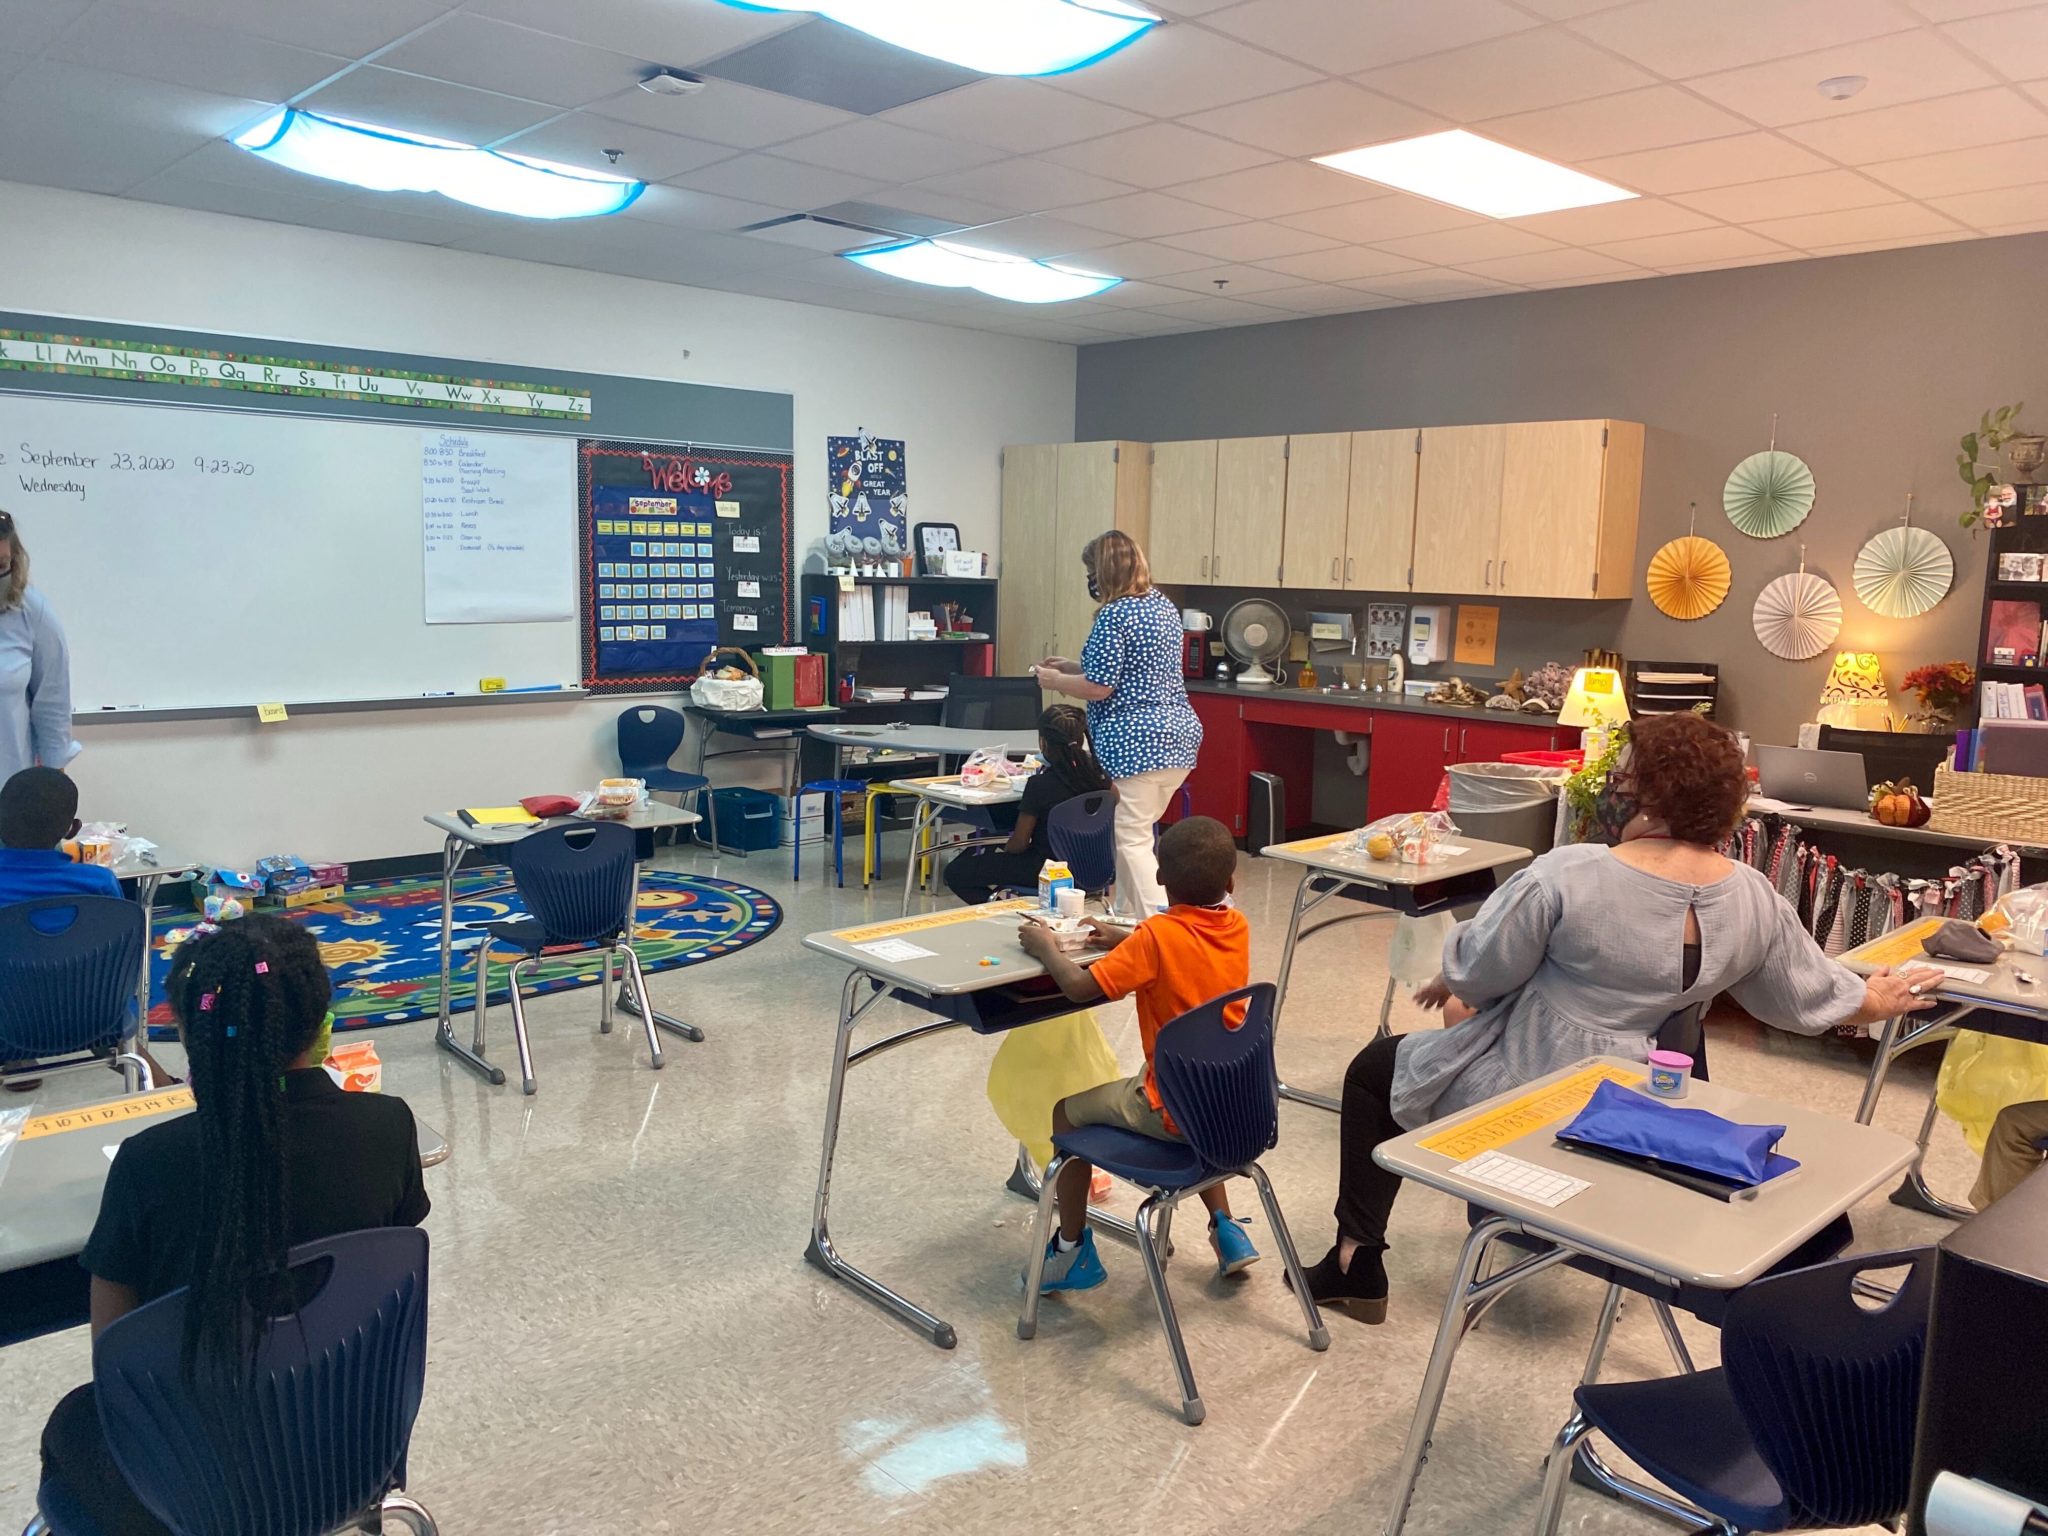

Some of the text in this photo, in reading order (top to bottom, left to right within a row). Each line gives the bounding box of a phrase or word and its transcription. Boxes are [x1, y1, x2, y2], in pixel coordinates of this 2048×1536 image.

[36, 344, 52, 361] Ll
[66, 348, 98, 365] Mm
[112, 352, 137, 369] Nn
[150, 356, 176, 373] Oo
[190, 360, 208, 377] Pp
[219, 363, 245, 382] Qq
[264, 367, 280, 384] Rr
[299, 371, 316, 387] Ss
[332, 374, 346, 389] Tt
[358, 377, 379, 393] Uu
[406, 381, 424, 396] Vv
[446, 385, 472, 401] Ww
[482, 389, 501, 404] Xx
[527, 394, 543, 410] Yy
[568, 398, 584, 412] Zz
[20, 442, 98, 470] September
[855, 451, 884, 461] BLAST
[643, 456, 732, 499] Welcme
[868, 463, 883, 473] OFF
[19, 475, 85, 501] Wednesday
[725, 522, 751, 537] Today
[725, 566, 760, 583] Yesterday
[719, 599, 757, 614] Tomorrow
[56, 1117, 72, 1128] 10
[80, 1112, 93, 1123] 11
[101, 1110, 114, 1120] 12
[124, 1103, 140, 1114] 13
[144, 1099, 161, 1110] 14
[167, 1095, 185, 1106] 15
